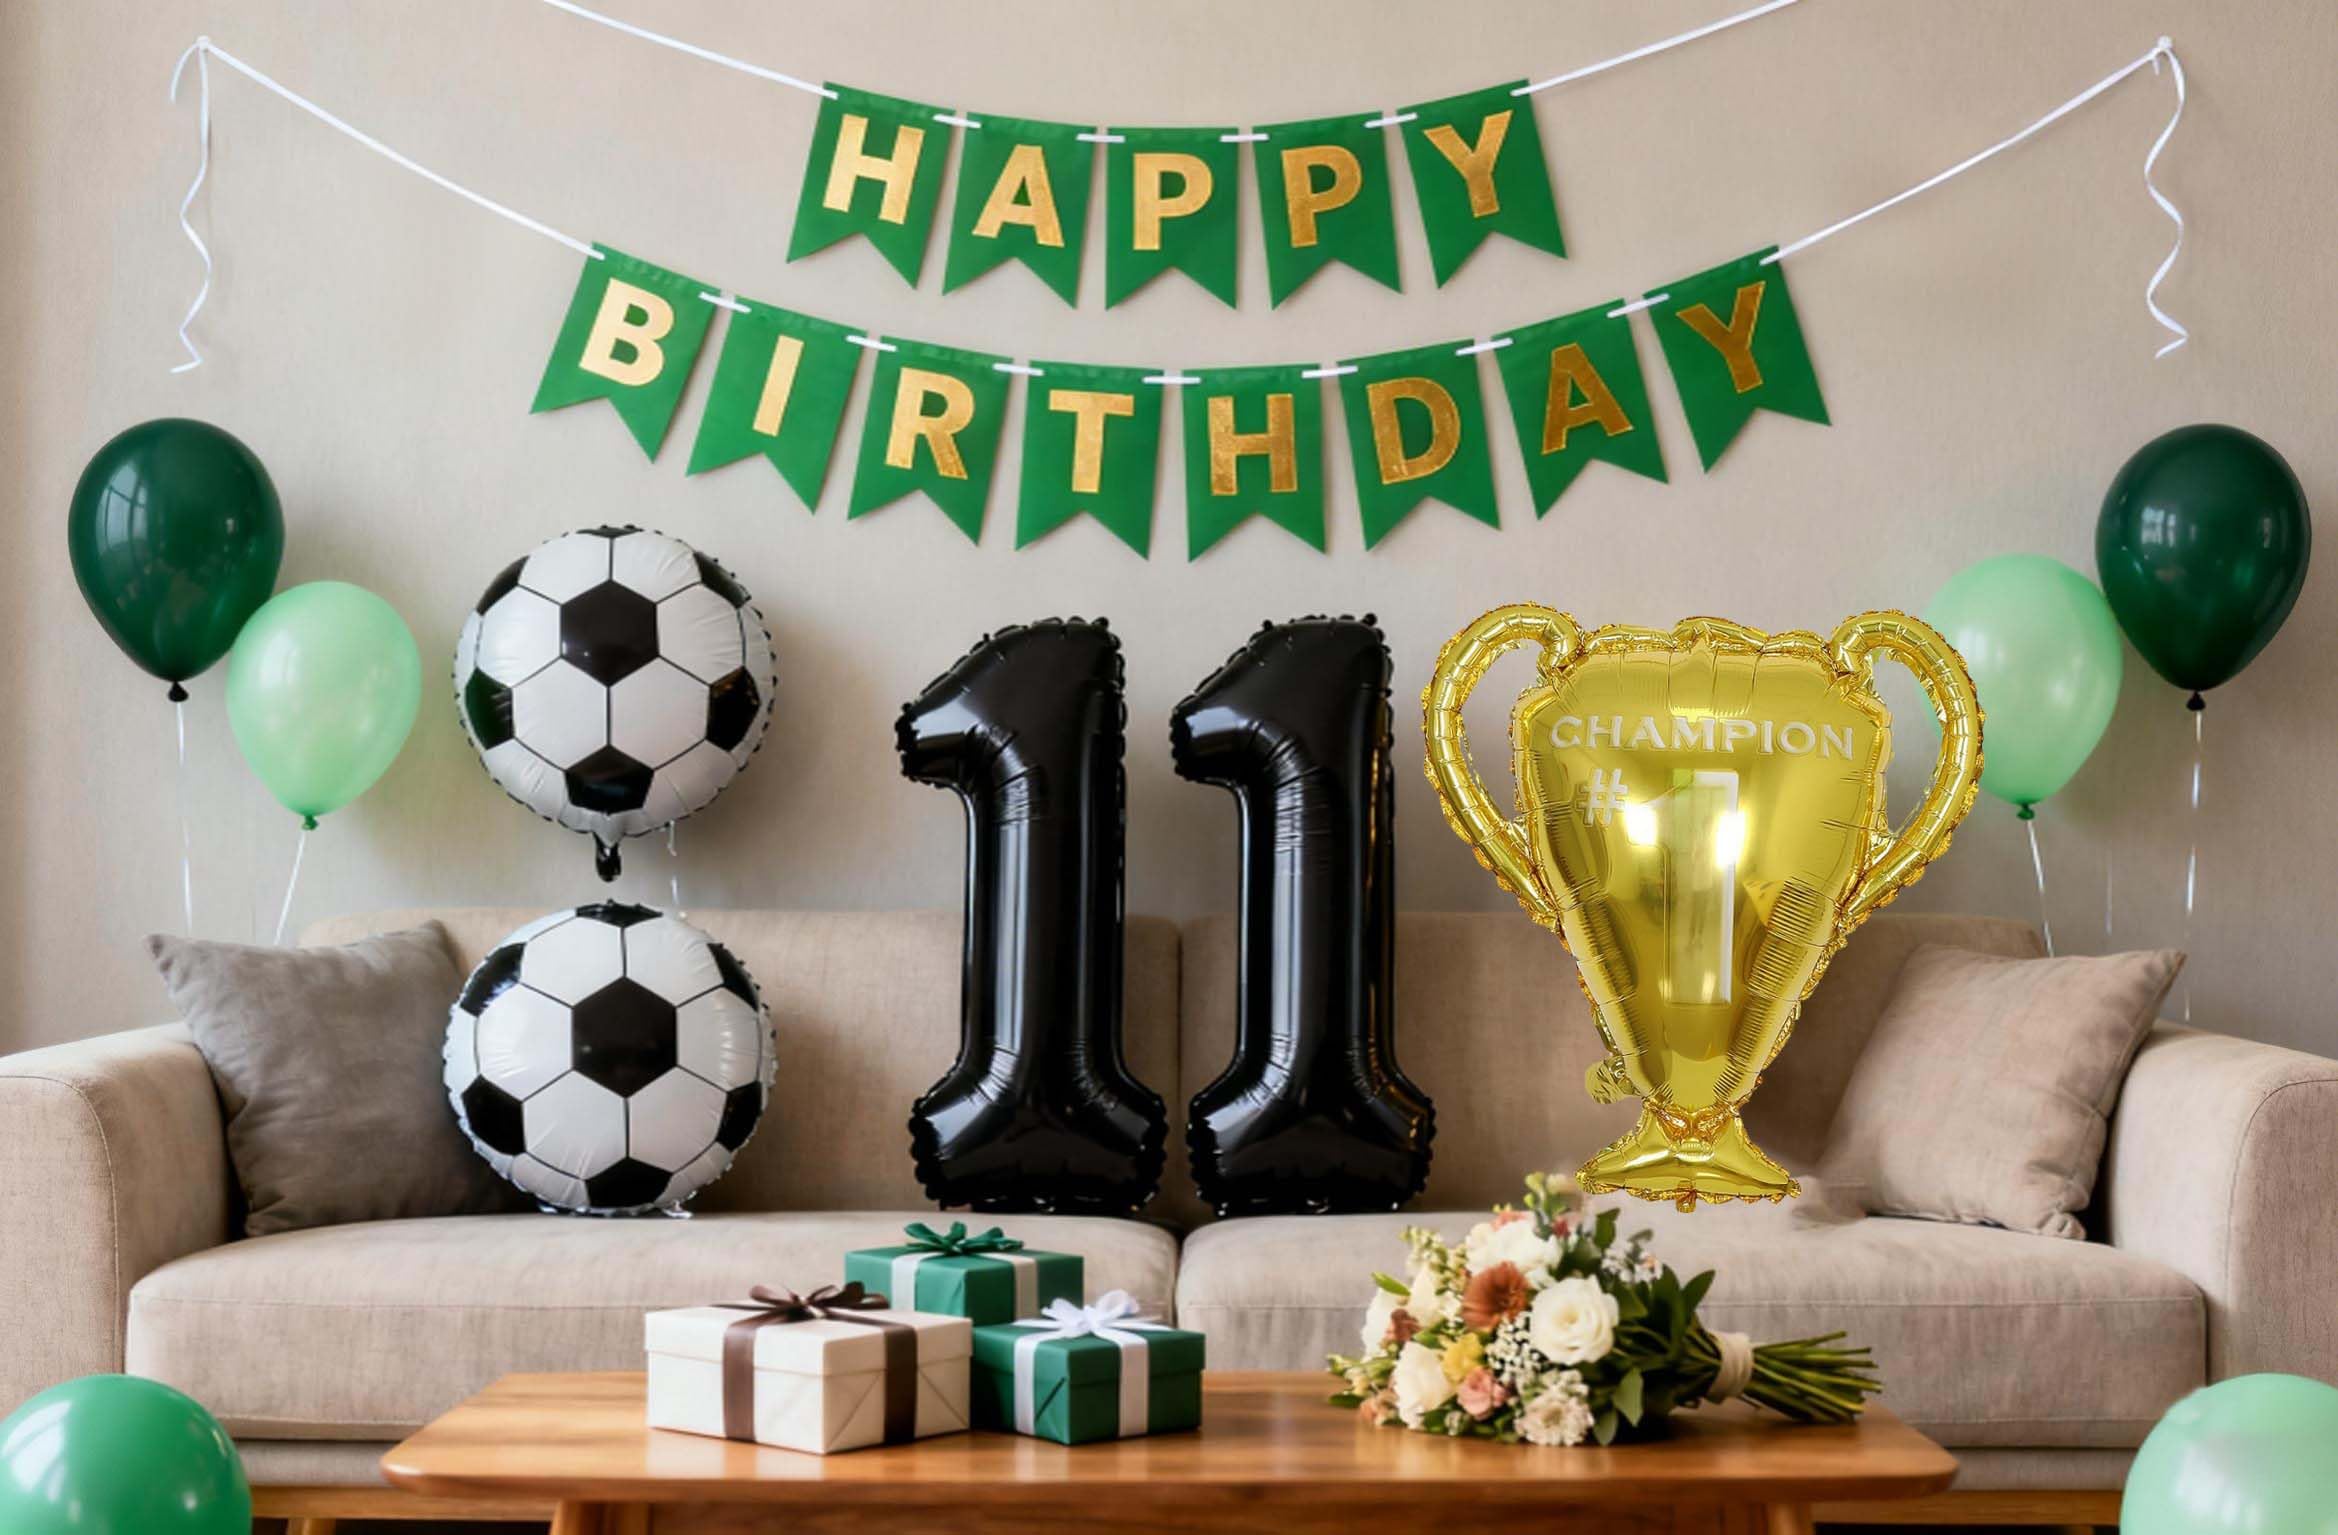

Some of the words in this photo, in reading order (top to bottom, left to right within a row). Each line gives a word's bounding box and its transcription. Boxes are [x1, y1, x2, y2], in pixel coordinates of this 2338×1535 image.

[824, 109, 1512, 251] HAPPY
[578, 279, 1767, 496] BIRTHDAY
[1551, 715, 1854, 761] CHAMPION
[894, 614, 1438, 1214] 11
